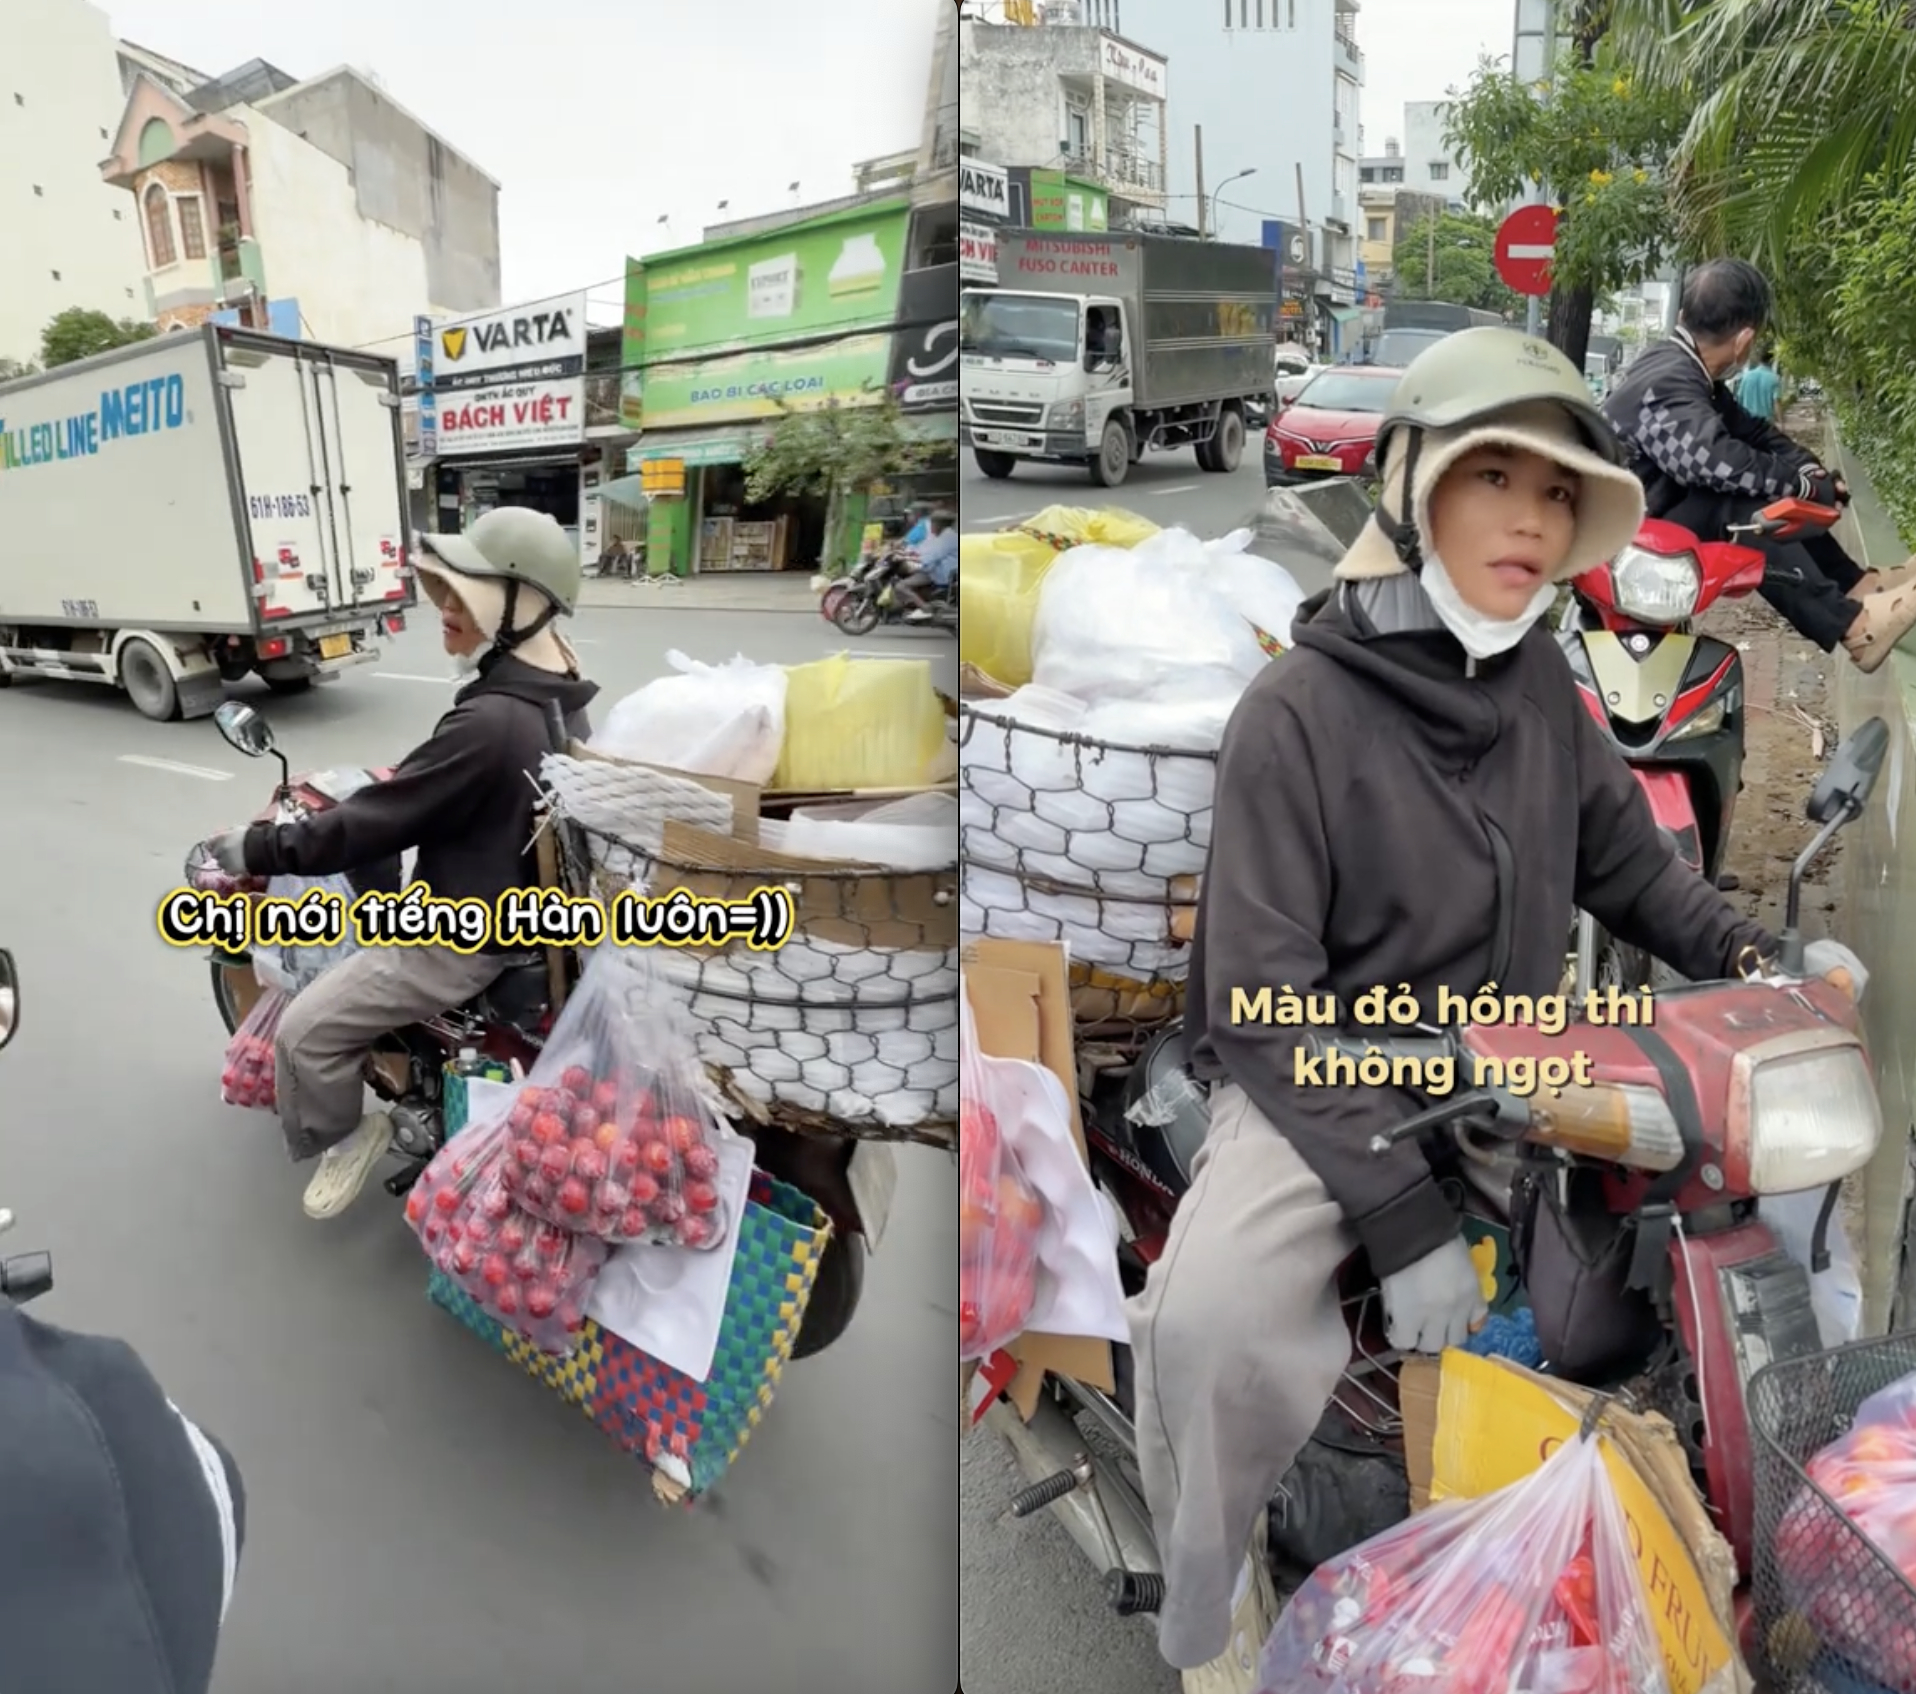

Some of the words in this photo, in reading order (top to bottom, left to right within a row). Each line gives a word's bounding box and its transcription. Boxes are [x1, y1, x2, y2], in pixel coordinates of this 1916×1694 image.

[1018, 256, 1056, 273] FUSO
[1060, 259, 1118, 277] CANTER
[1026, 239, 1110, 256] MITSUBISHI
[473, 310, 571, 353] VARTA
[56, 411, 99, 460] LINE
[101, 373, 184, 442] MEITO
[442, 401, 505, 432] BÁCH
[513, 392, 573, 427] VIỆT
